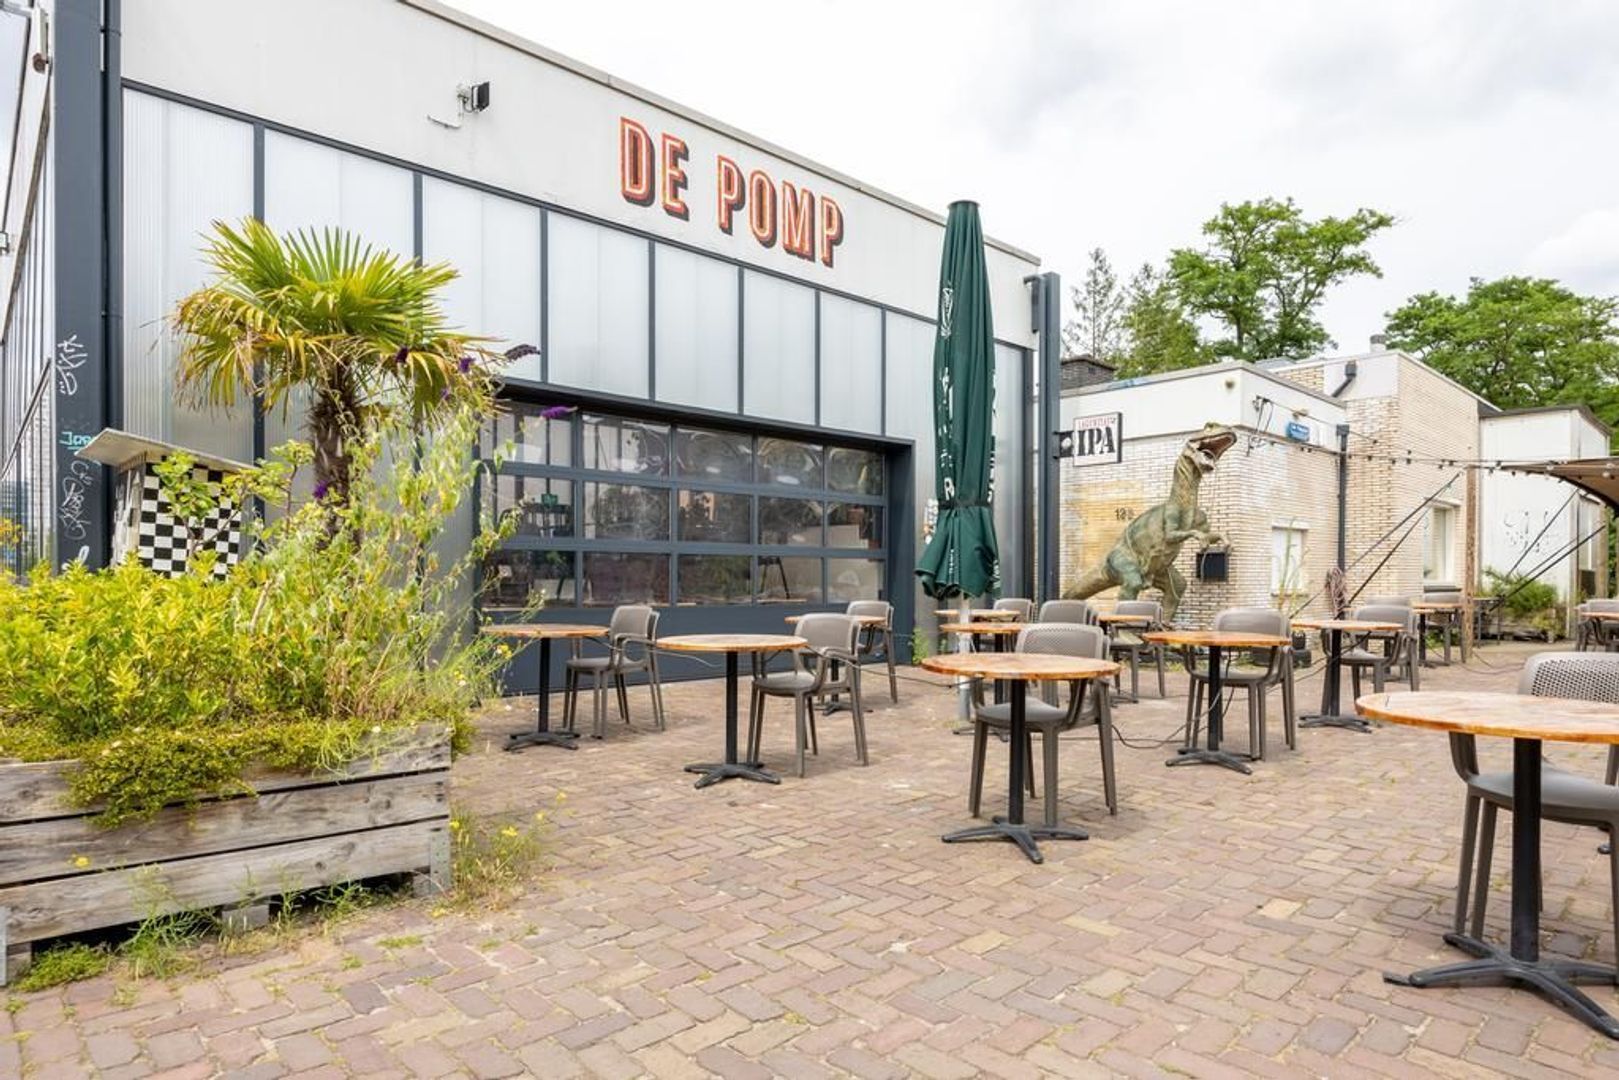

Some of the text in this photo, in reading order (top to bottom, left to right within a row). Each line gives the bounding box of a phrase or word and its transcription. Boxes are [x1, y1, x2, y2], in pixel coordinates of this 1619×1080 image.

[620, 116, 844, 269] DE POMP
[1077, 426, 1116, 457] IPA
